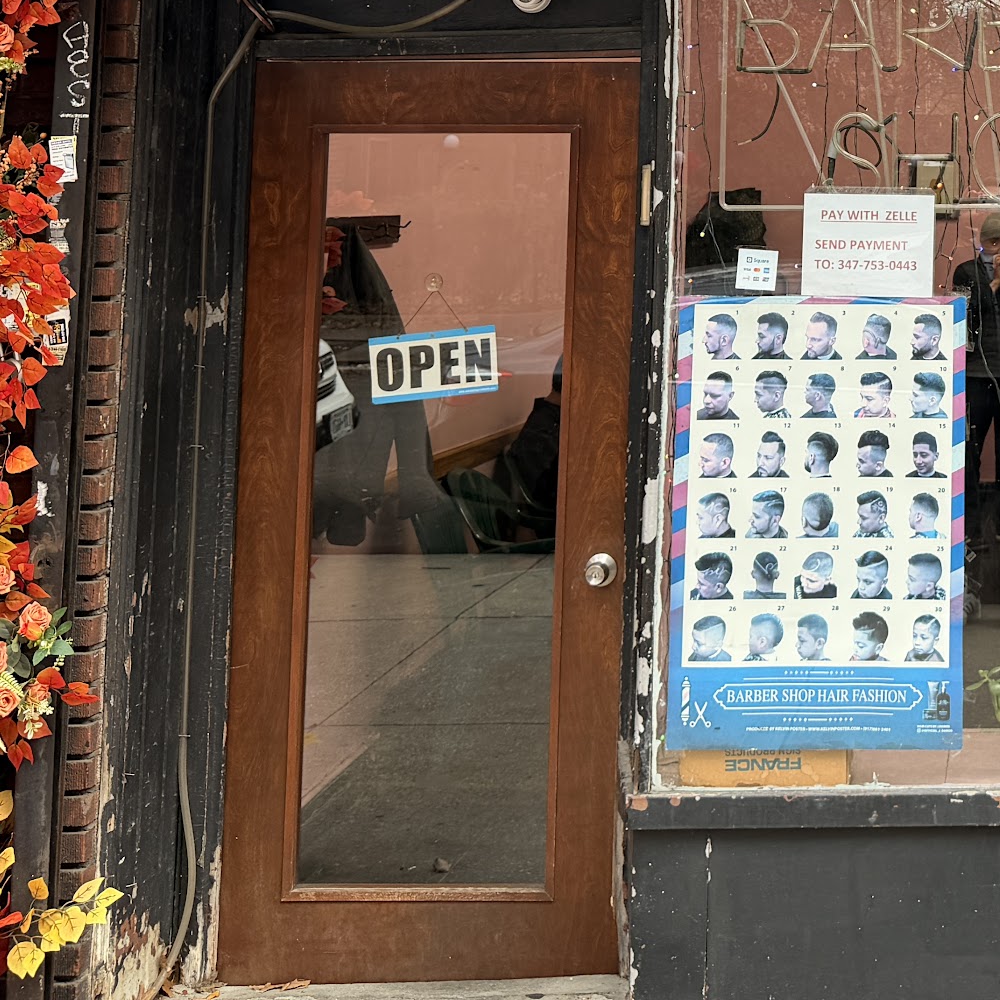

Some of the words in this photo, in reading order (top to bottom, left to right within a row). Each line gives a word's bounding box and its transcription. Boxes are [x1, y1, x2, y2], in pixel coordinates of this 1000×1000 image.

[820, 209, 845, 221] PAY
[847, 210, 879, 221] WITH
[885, 210, 918, 222] ZELLE
[814, 239, 847, 250] SEND
[849, 240, 909, 252] PAYMENT
[814, 259, 835, 270] TO:
[837, 259, 917, 271] 347-753-0443
[376, 338, 492, 392] OPEN
[726, 688, 779, 703] BARBER
[781, 688, 816, 702] SHOP
[817, 688, 849, 703] HAIR
[852, 689, 908, 704] FASHION
[725, 757, 802, 772] FRANCE
